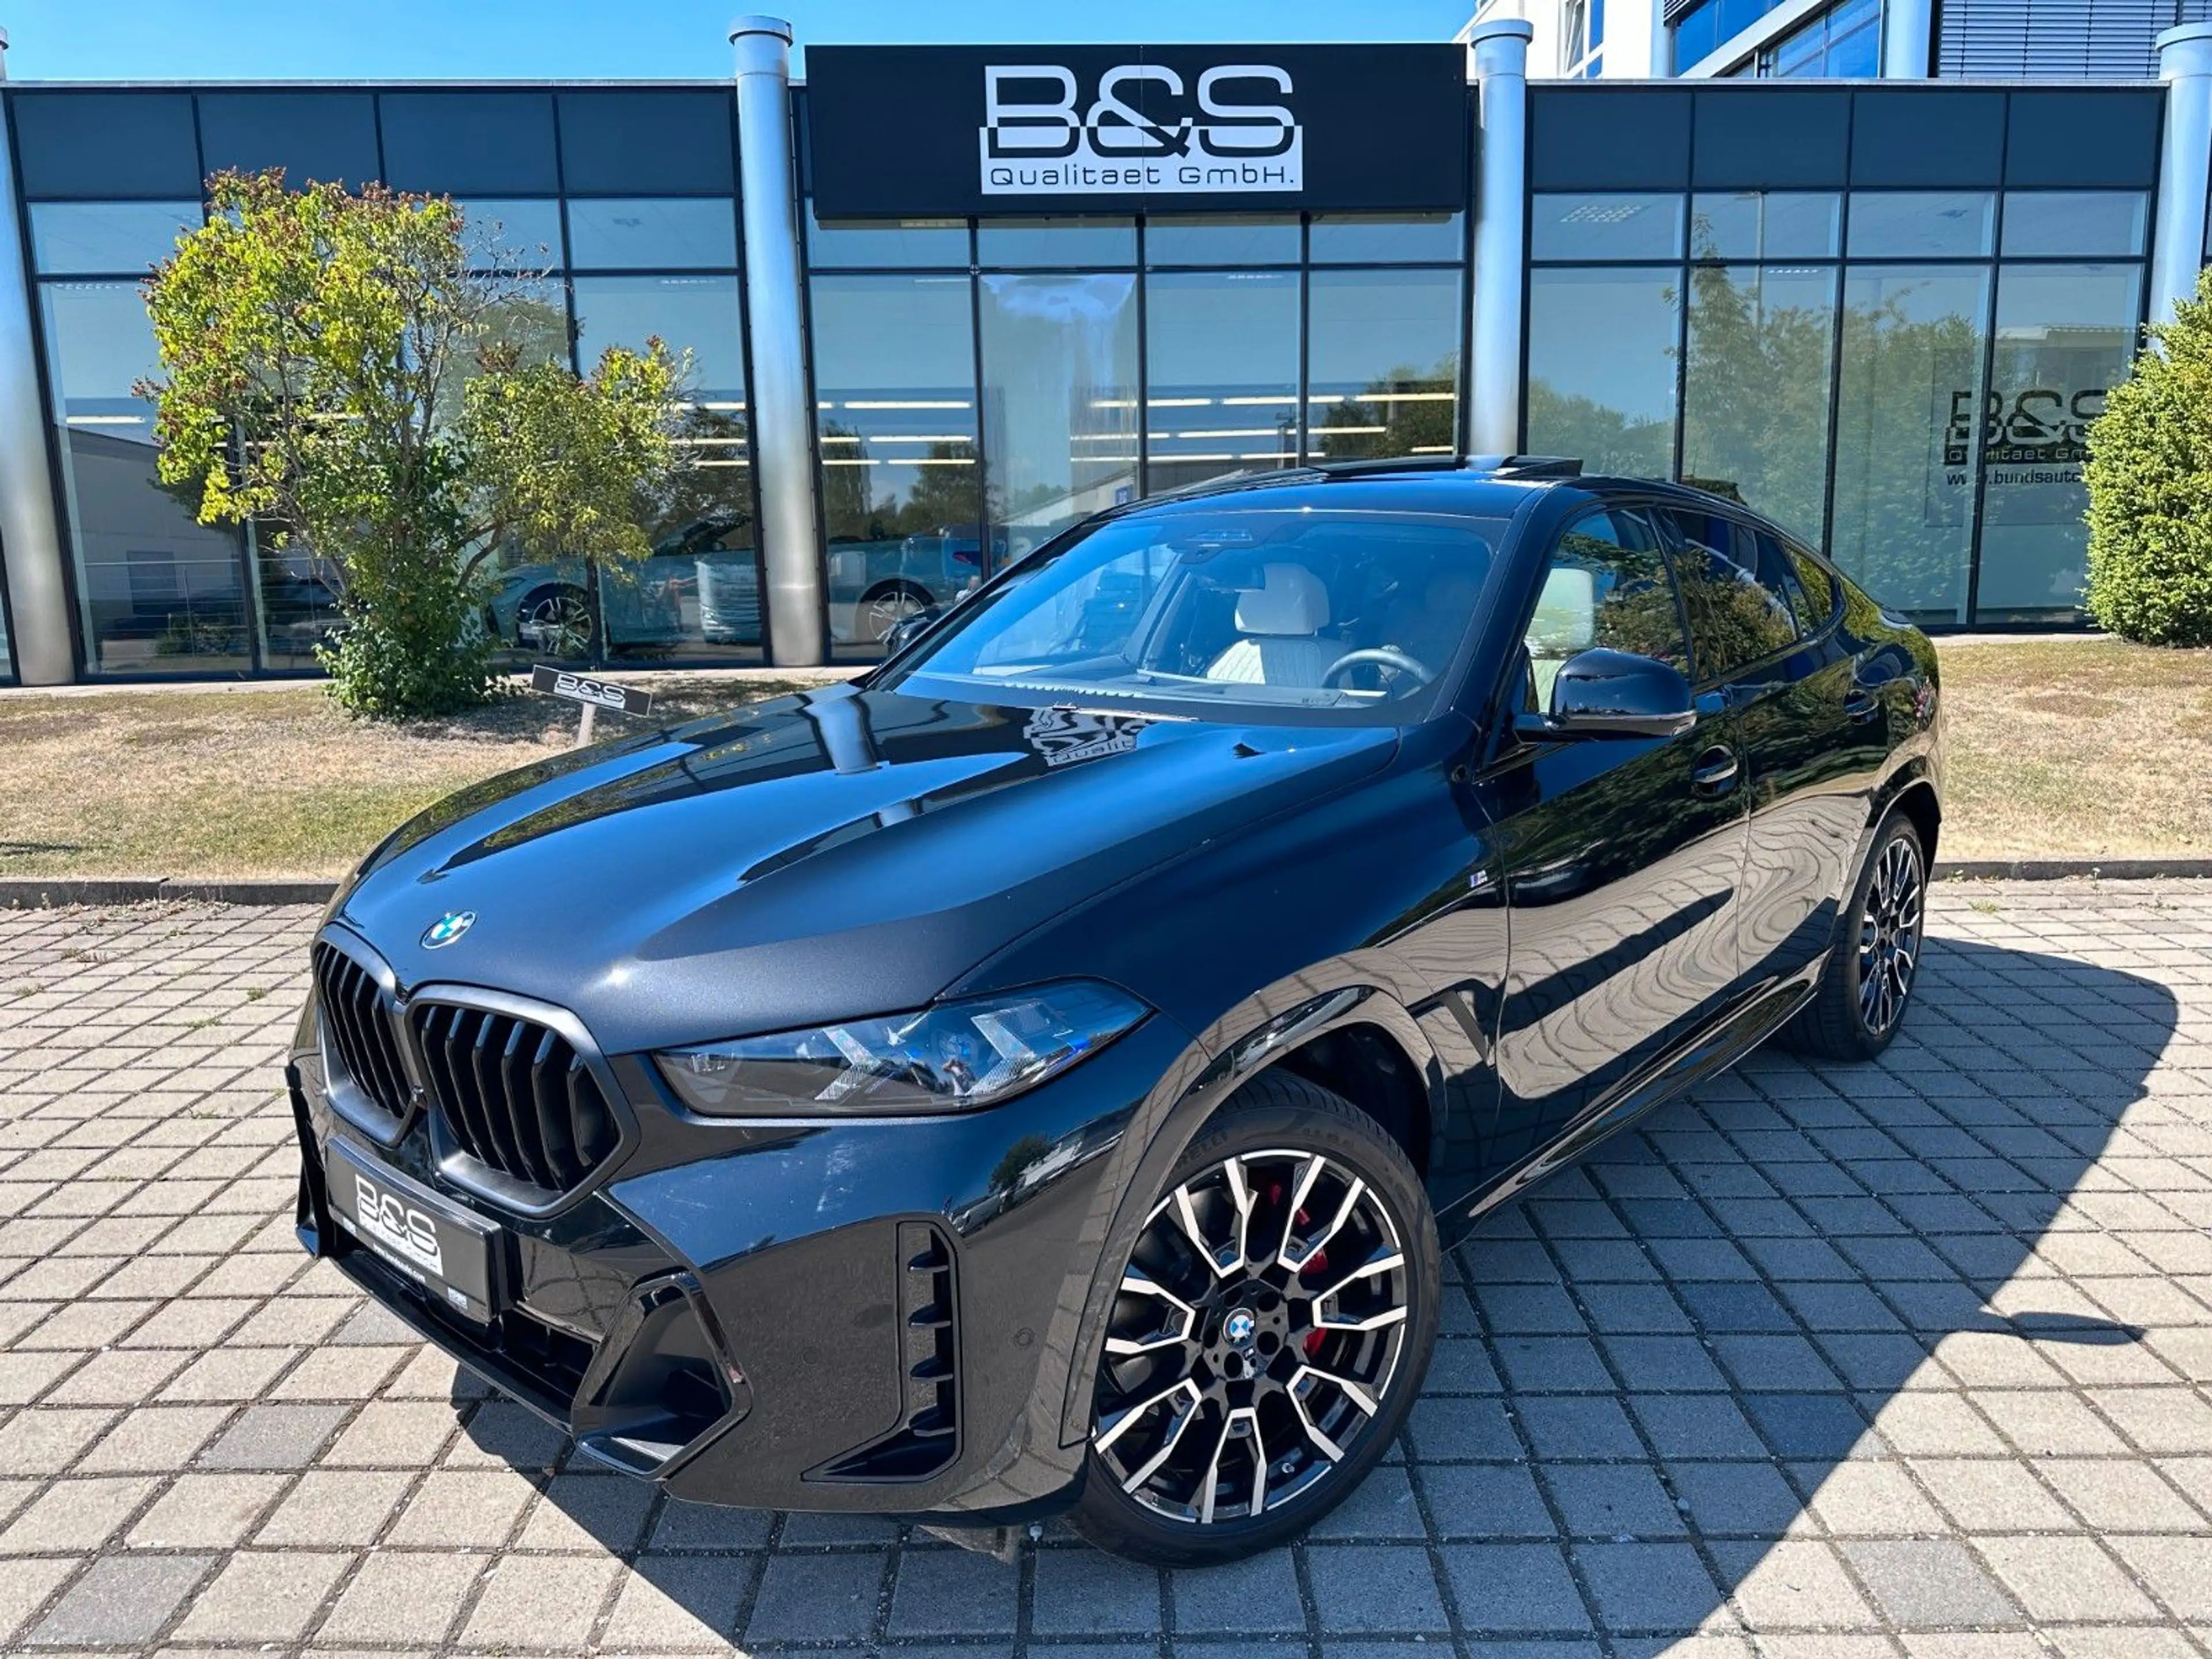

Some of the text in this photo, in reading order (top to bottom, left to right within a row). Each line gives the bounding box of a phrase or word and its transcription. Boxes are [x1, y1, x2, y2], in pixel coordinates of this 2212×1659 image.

[984, 65, 1296, 159] B&S
[990, 162, 1295, 186] Qualitaet GmbH.
[556, 673, 626, 703] B&S
[355, 1173, 439, 1257] B&S
